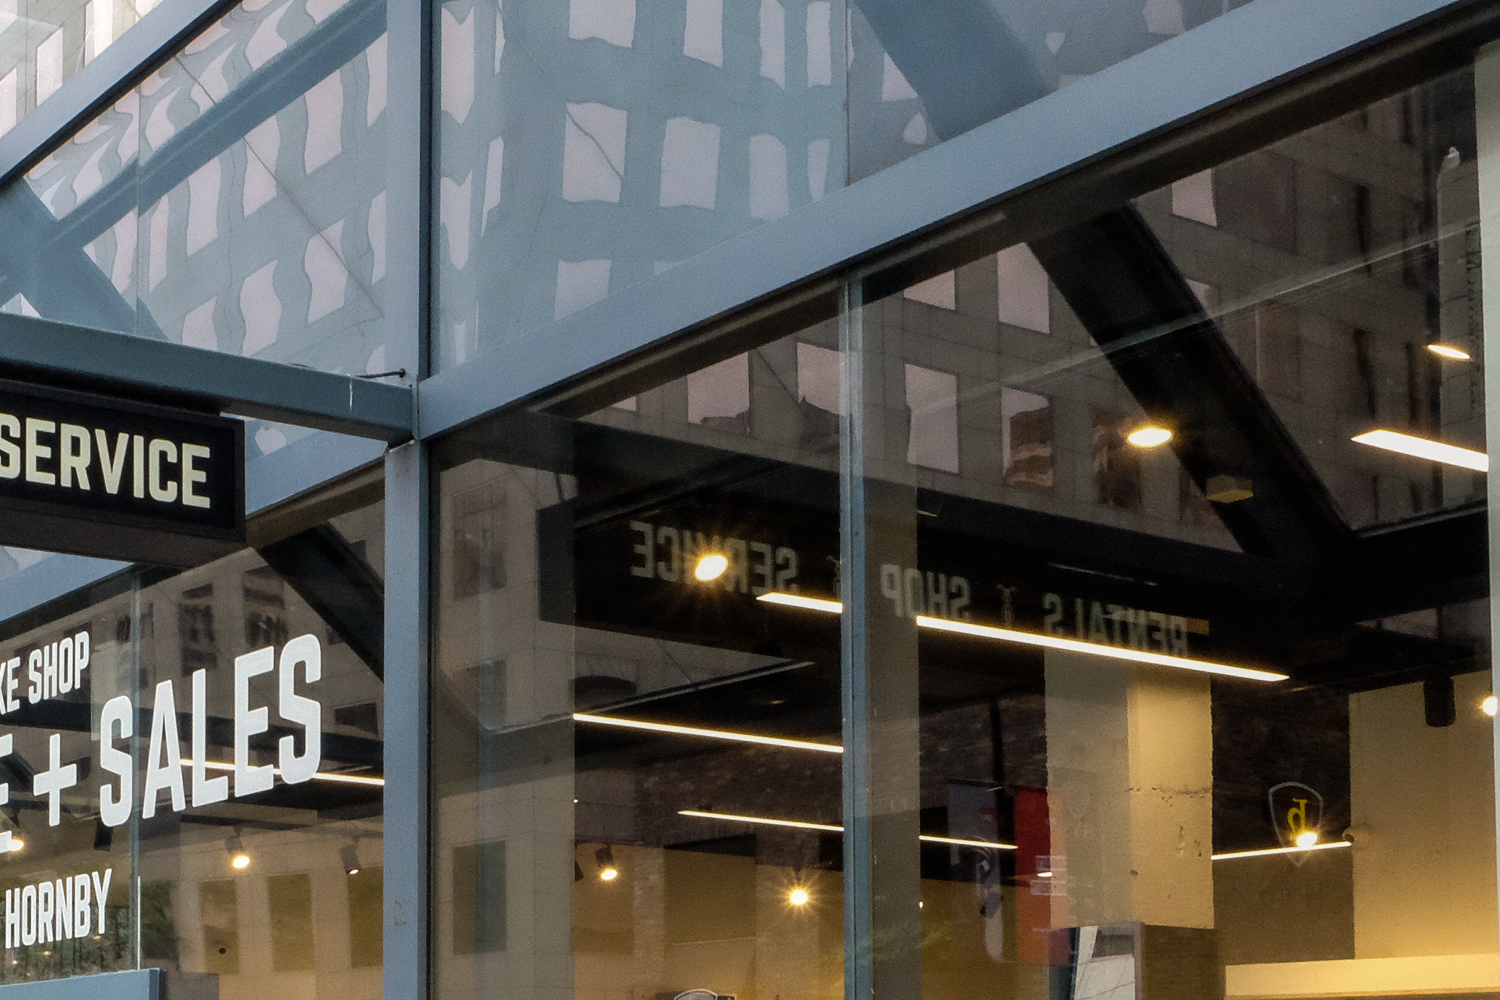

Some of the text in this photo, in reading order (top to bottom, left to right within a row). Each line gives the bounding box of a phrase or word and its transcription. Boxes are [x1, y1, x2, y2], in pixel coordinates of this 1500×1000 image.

[28, 630, 91, 705] SHOP
[32, 733, 78, 827] +
[99, 633, 323, 828] SALES
[5, 868, 113, 950] HORNBY
